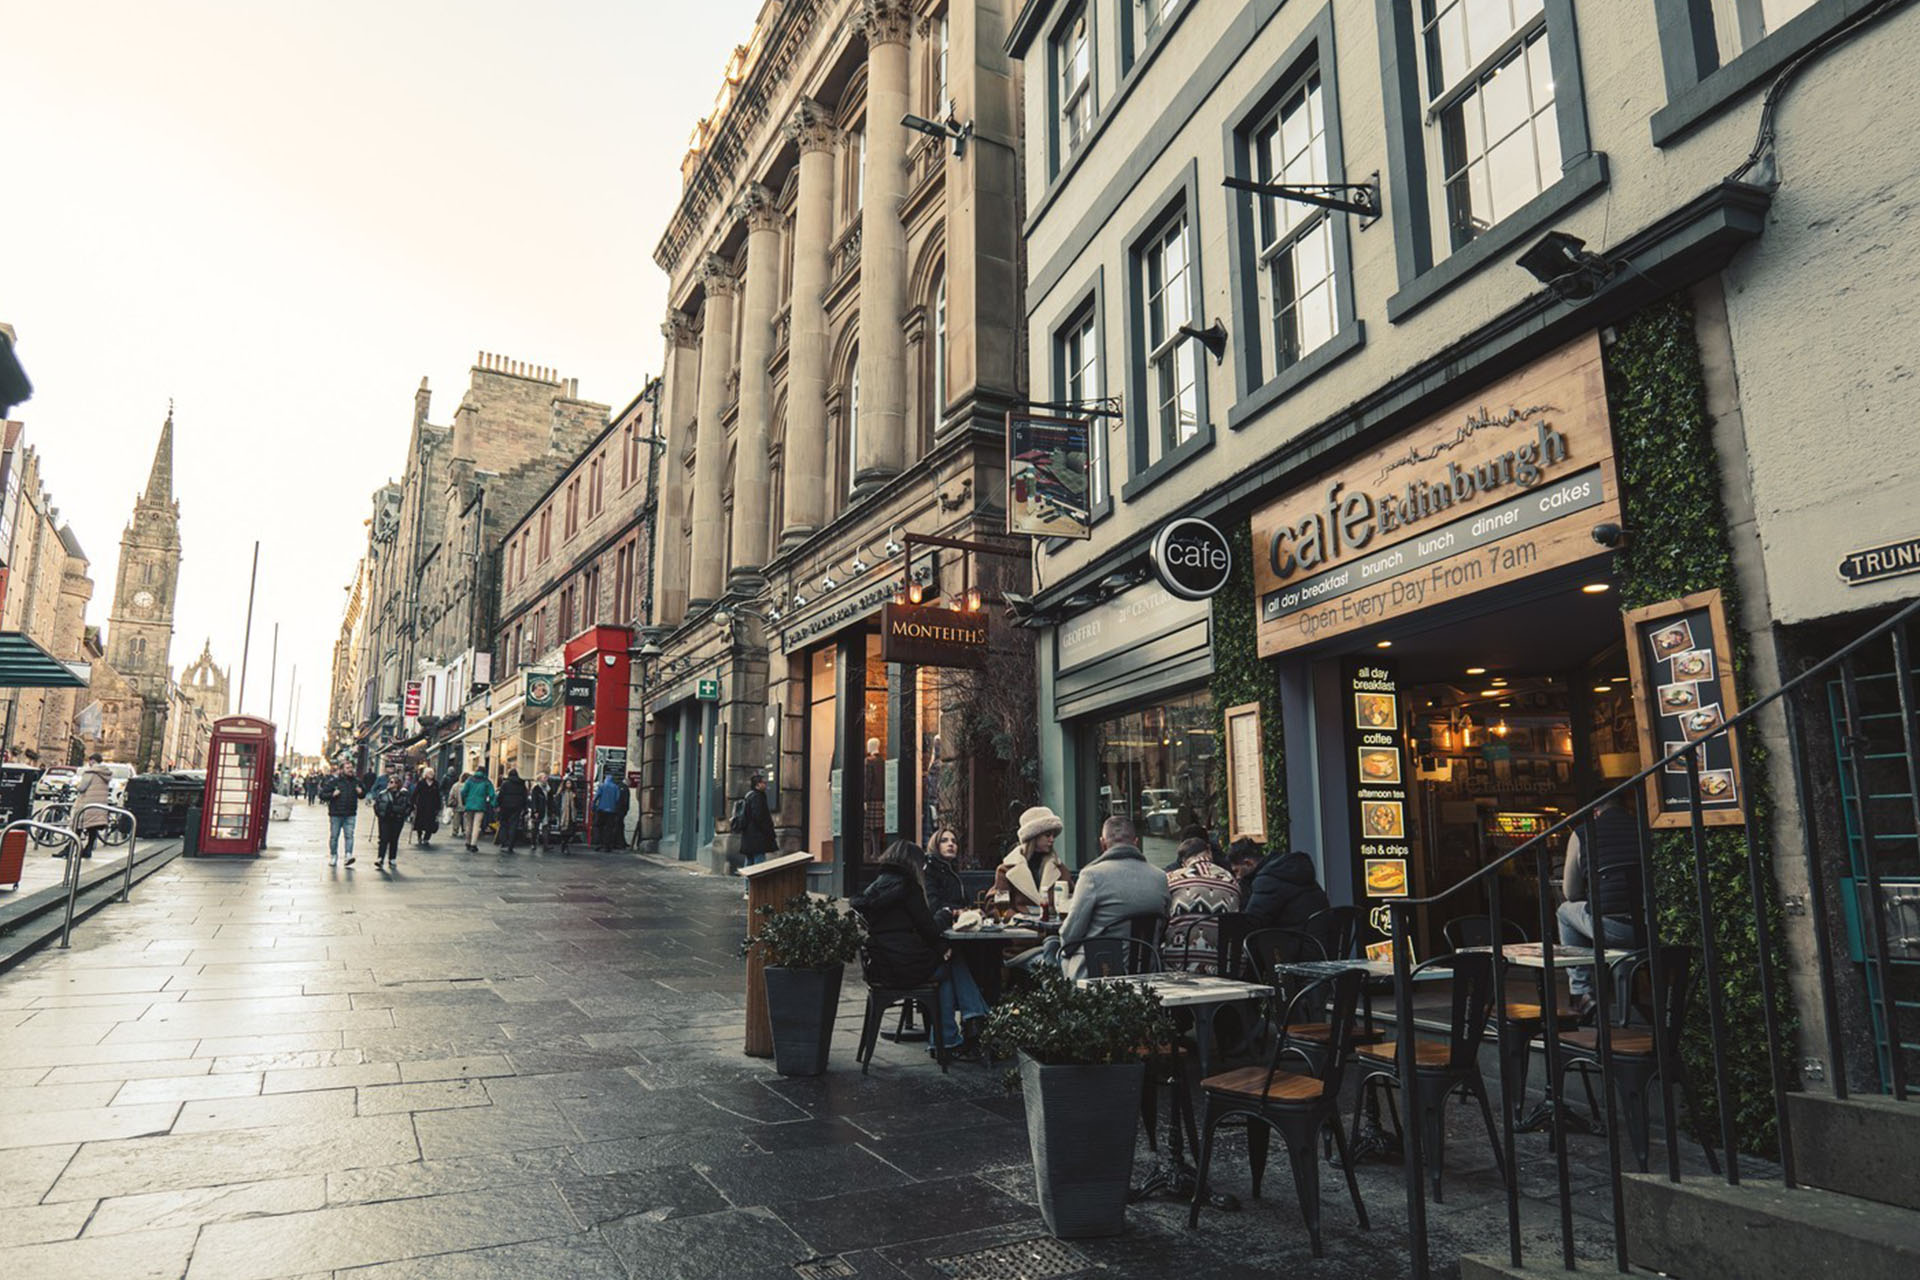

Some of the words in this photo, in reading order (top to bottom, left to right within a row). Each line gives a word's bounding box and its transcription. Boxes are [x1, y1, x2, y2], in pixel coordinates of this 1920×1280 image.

[1270, 481, 1372, 579] cafe
[1376, 420, 1565, 535] Edinburgh
[1167, 541, 1226, 570] cafe
[1268, 597, 1279, 613] all
[1281, 591, 1299, 608] day
[1301, 571, 1348, 600] breakfast
[1361, 551, 1403, 577] brunch
[1417, 532, 1454, 557] lunch
[1471, 507, 1519, 536] dinner
[1539, 481, 1590, 512] cakes
[1300, 609, 1337, 637] Open
[1341, 591, 1386, 621] Every
[1391, 577, 1426, 606] Day
[1431, 559, 1482, 592] From
[1488, 541, 1537, 575] 7am
[892, 620, 985, 644] MONTEITHS
[1063, 620, 1101, 648] GEOFFREY
[1352, 678, 1396, 691] breakfast
[1358, 666, 1370, 678] all
[1371, 667, 1389, 681] day
[1363, 732, 1393, 744] coffee
[1357, 789, 1392, 798] afternoon
[1393, 790, 1405, 798] tea
[1361, 844, 1377, 855] fish
[1377, 844, 1385, 855] &
[1386, 844, 1409, 856] chips
